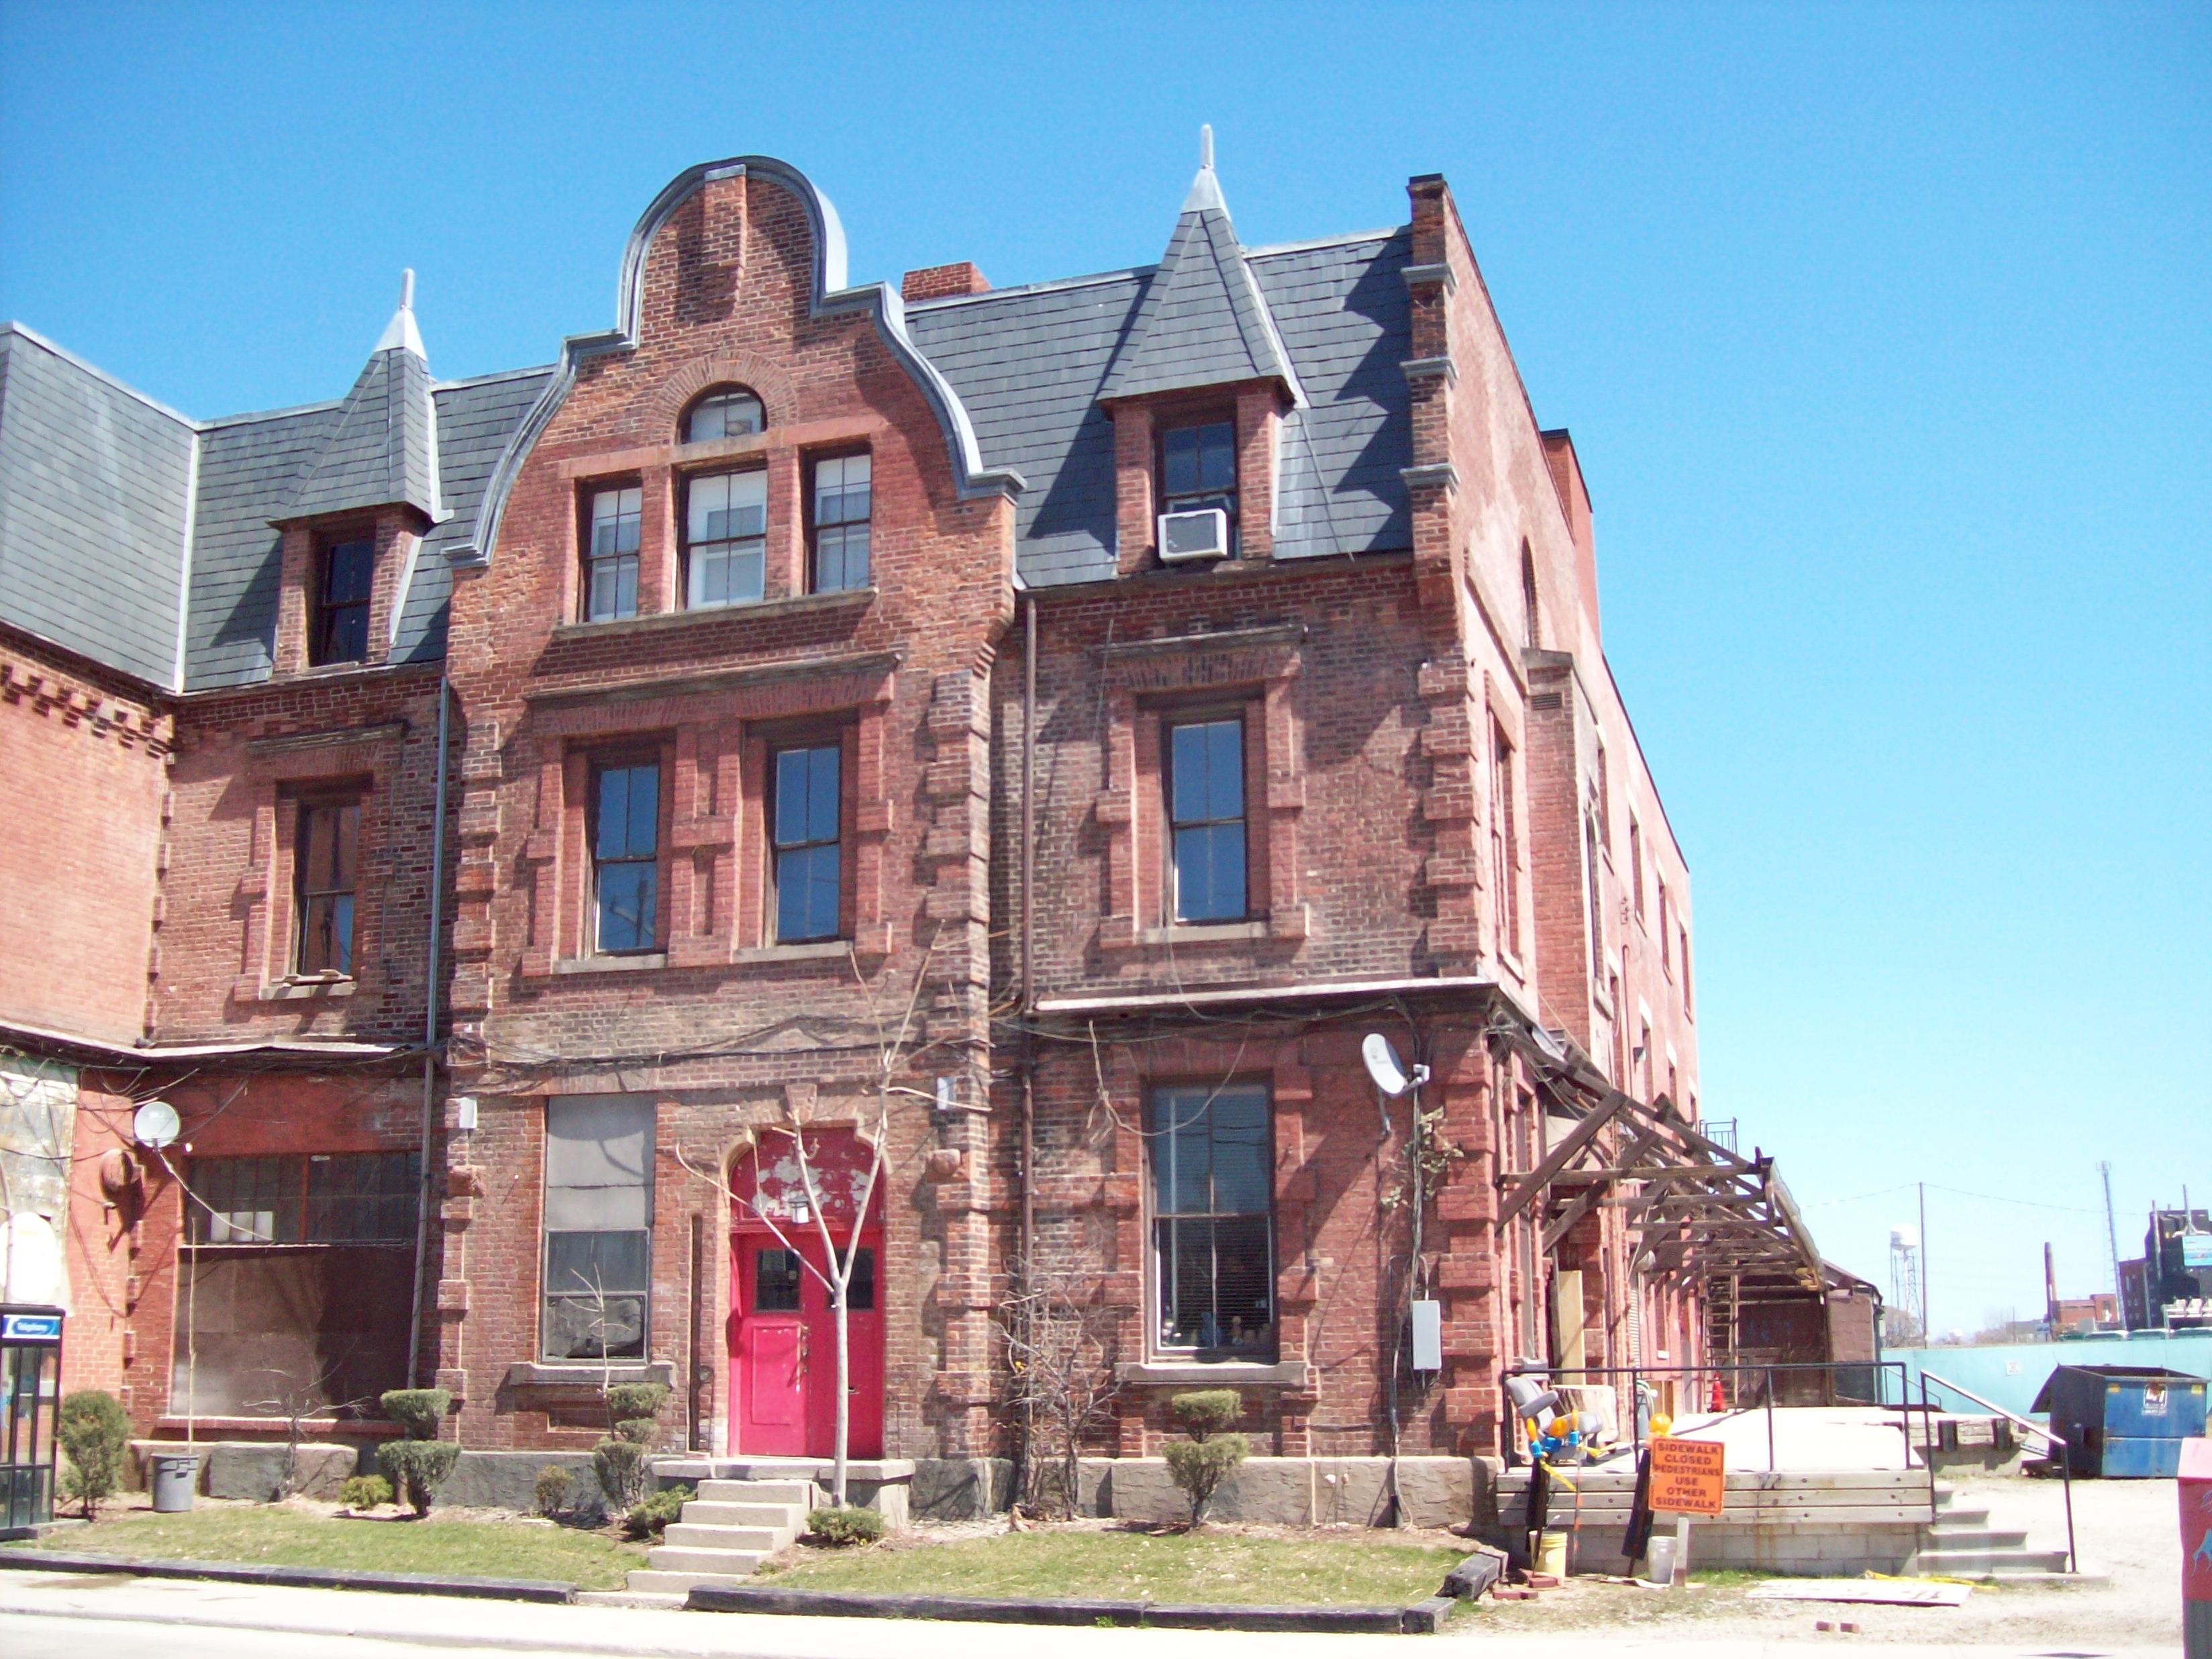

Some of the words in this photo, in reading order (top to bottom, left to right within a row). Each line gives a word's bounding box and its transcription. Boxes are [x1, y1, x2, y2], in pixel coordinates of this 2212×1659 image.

[1664, 1454, 1711, 1465] CLOSED
[1654, 1464, 1720, 1476] PEDESTRIANS
[1676, 1476, 1697, 1485] USE
[1667, 1487, 1707, 1497] OTHER
